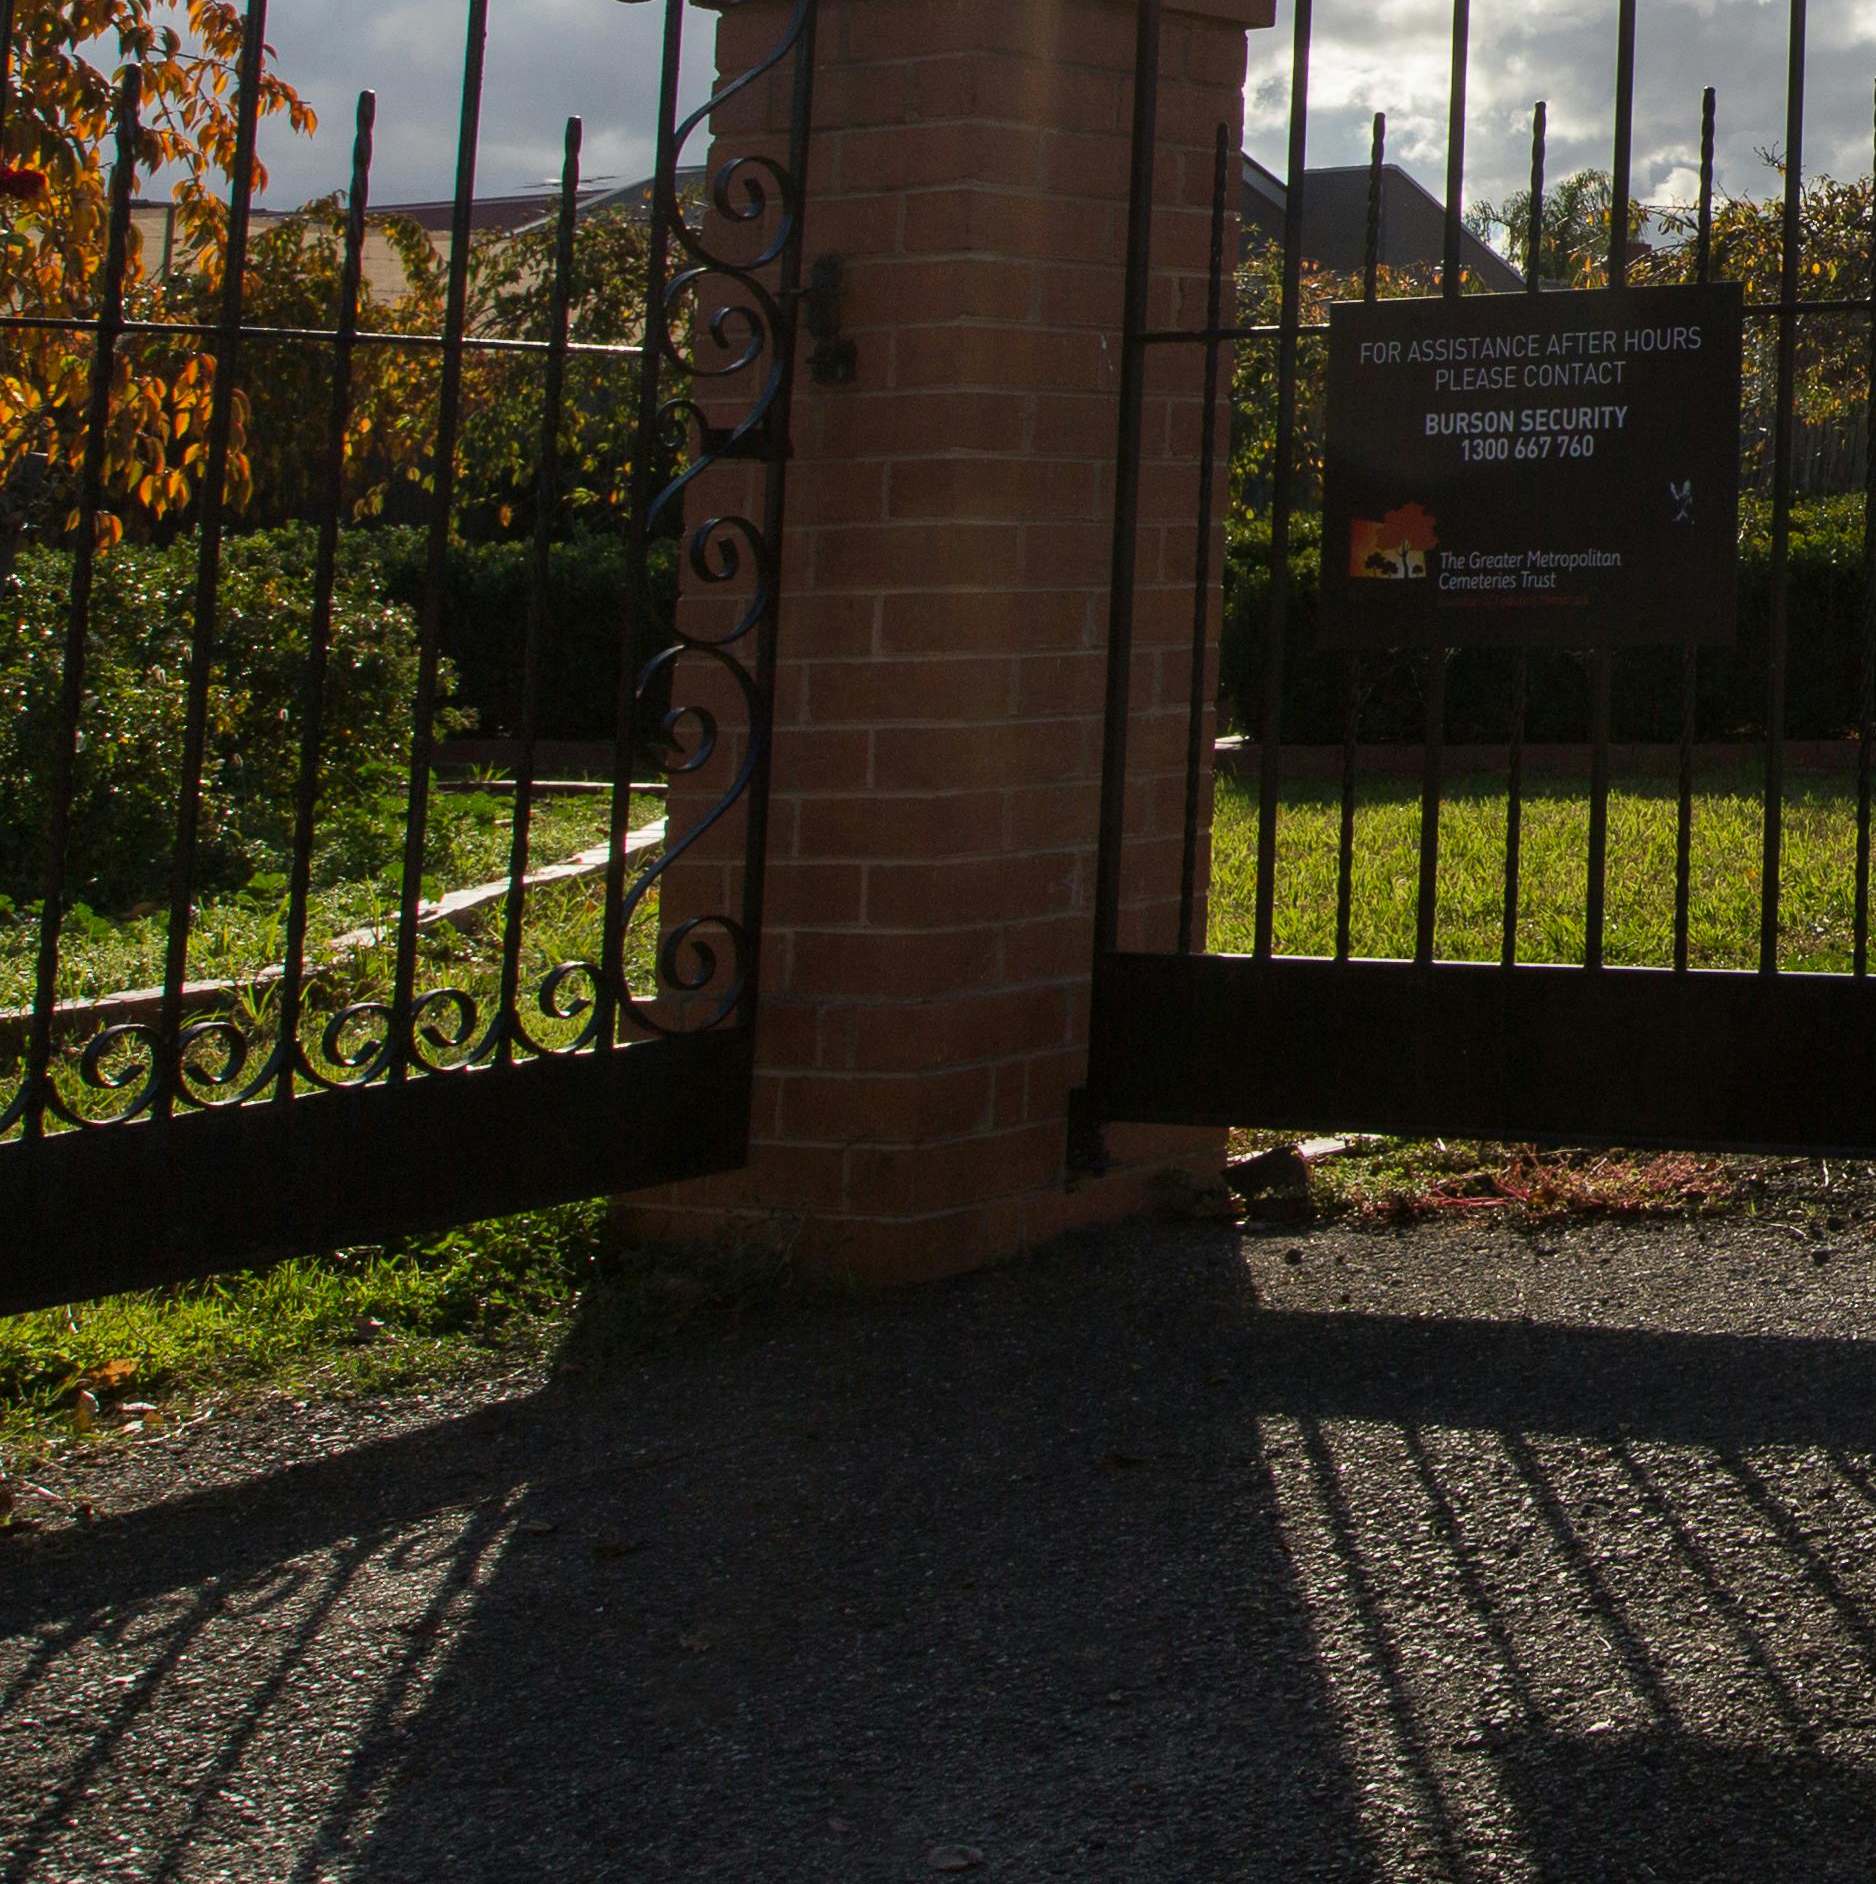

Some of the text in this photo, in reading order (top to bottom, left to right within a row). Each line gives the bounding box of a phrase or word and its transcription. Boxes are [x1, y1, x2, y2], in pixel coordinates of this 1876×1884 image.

[1360, 326, 1702, 365] FOR ASSISTANCE AFTER HOURS
[1435, 361, 1627, 391] PLEASE CONTACT
[1425, 406, 1628, 436] BURSON SECURITY
[1461, 435, 1595, 461] 1300 667 760
[1440, 548, 1622, 572] The Greater Metropolitan
[1438, 570, 1557, 590] Cemeteries Trust
